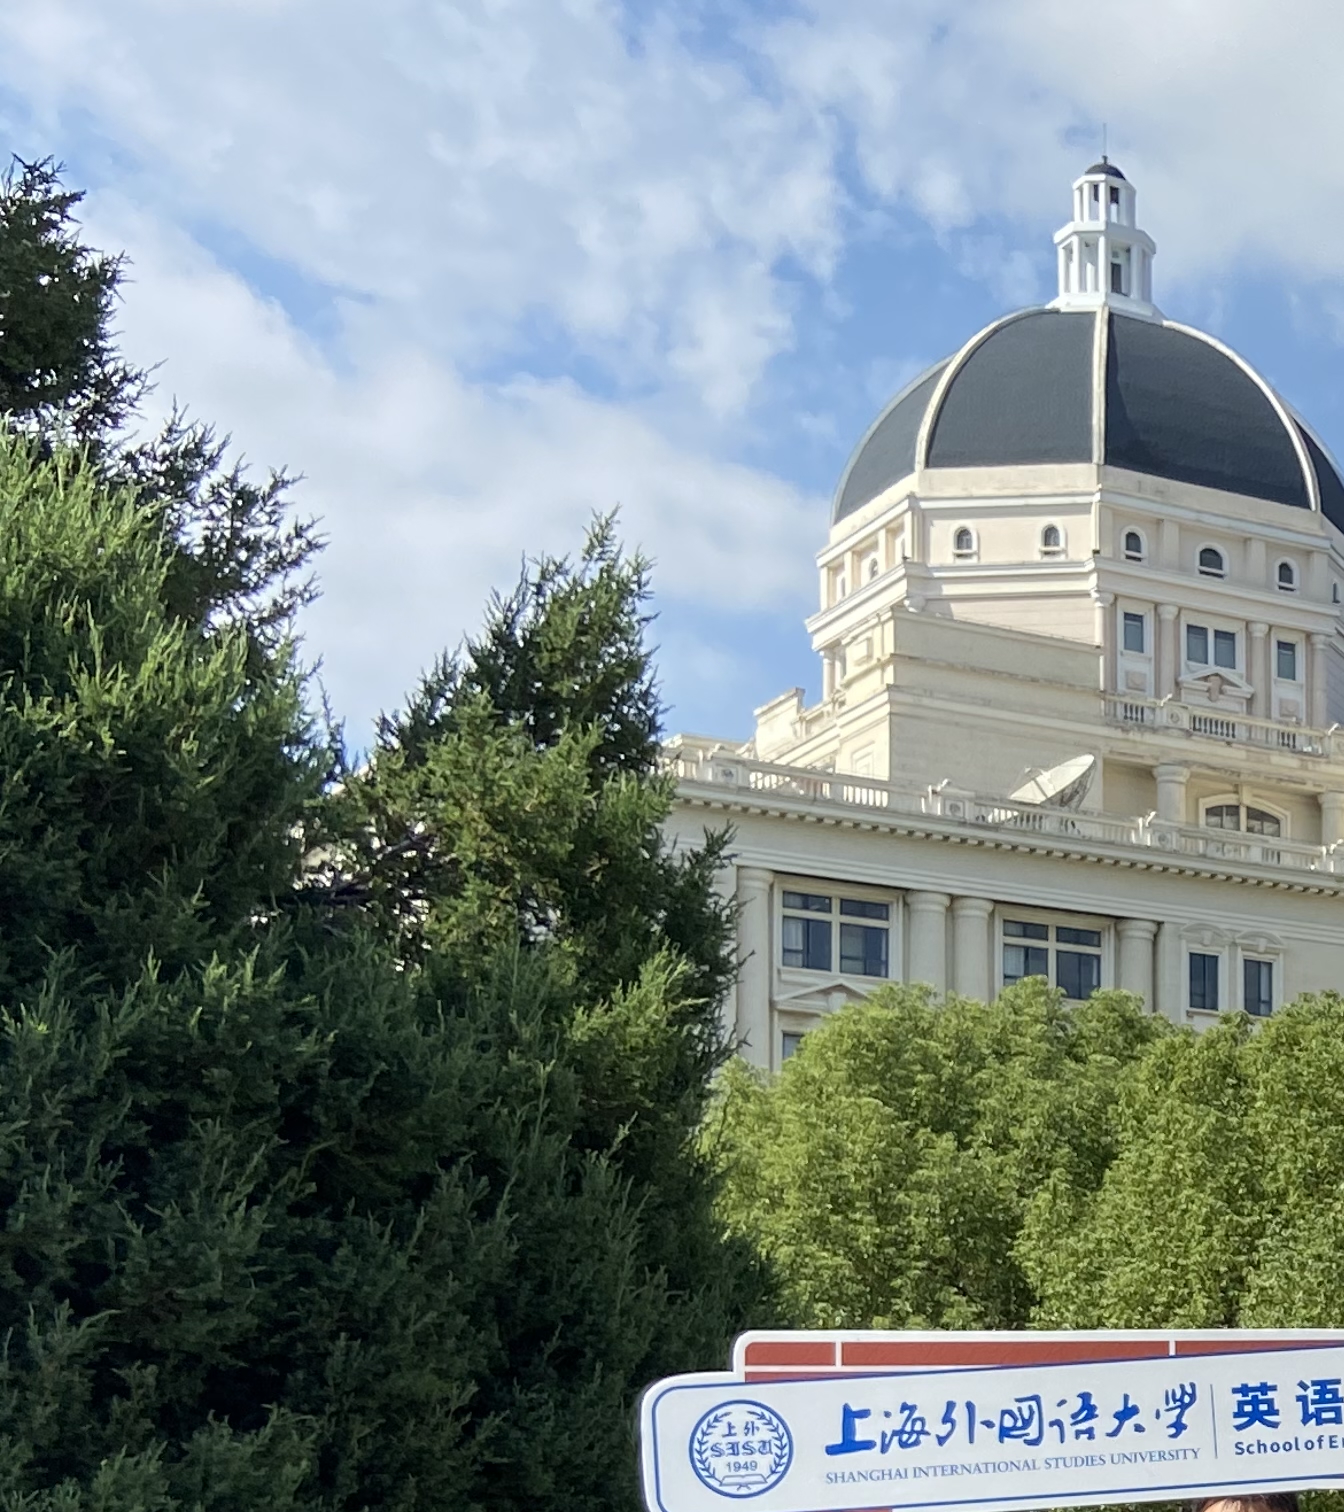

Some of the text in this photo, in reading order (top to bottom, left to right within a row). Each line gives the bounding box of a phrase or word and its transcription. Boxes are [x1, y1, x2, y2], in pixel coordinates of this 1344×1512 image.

[1234, 1436, 1301, 1456] School
[1304, 1434, 1324, 1450] of
[726, 1460, 758, 1472] 1949
[825, 1446, 1202, 1485] SHANGHAI INTERNATIONAL STUDIES UNIVERSITY
